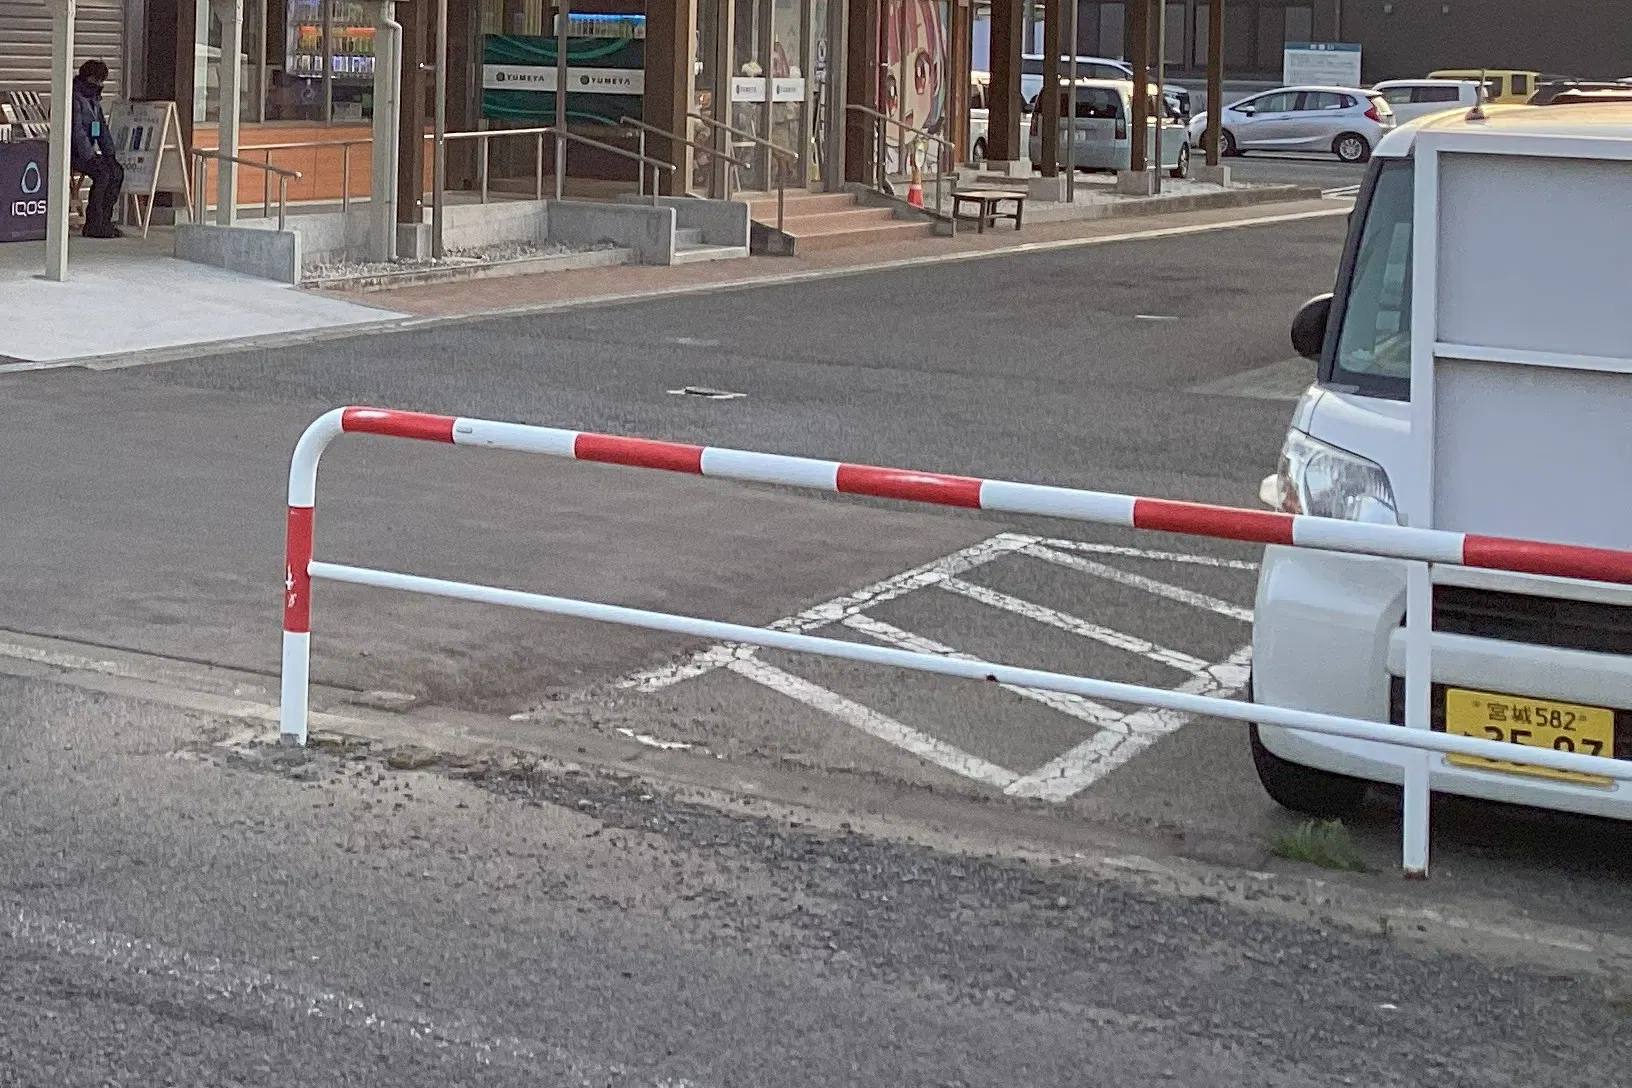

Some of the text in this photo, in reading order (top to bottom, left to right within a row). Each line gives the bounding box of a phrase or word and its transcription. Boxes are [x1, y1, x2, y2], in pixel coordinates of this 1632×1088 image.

[506, 73, 545, 82] YUMEYA
[591, 77, 631, 85] YUMEYA
[11, 200, 47, 217] IQOS
